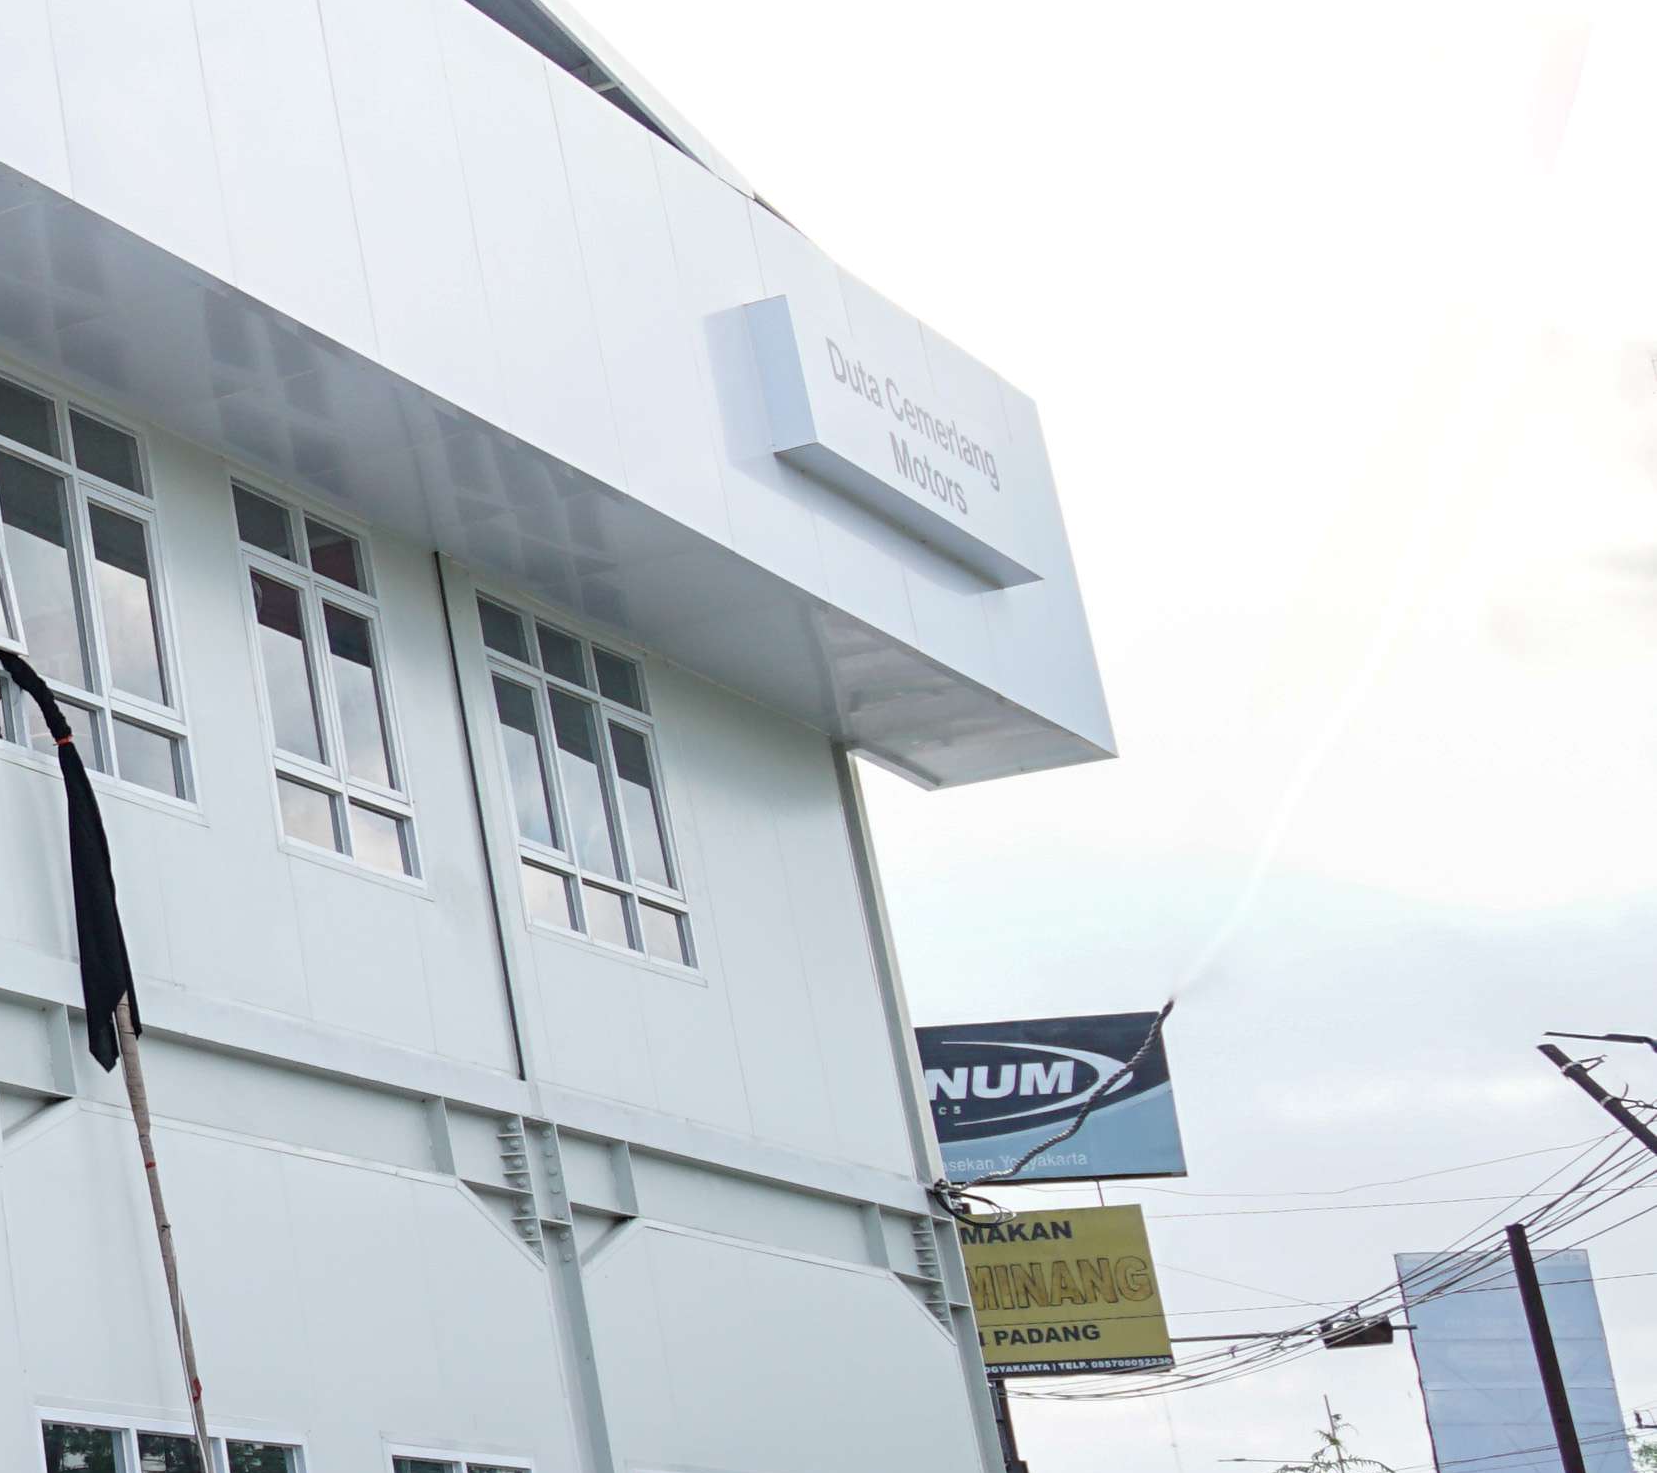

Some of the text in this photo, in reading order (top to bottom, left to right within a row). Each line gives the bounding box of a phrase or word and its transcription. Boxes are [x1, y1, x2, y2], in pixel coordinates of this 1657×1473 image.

[825, 336, 1000, 492] Duta Cemerlang
[890, 431, 968, 514] Motors
[994, 1325, 1101, 1346] PADANG
